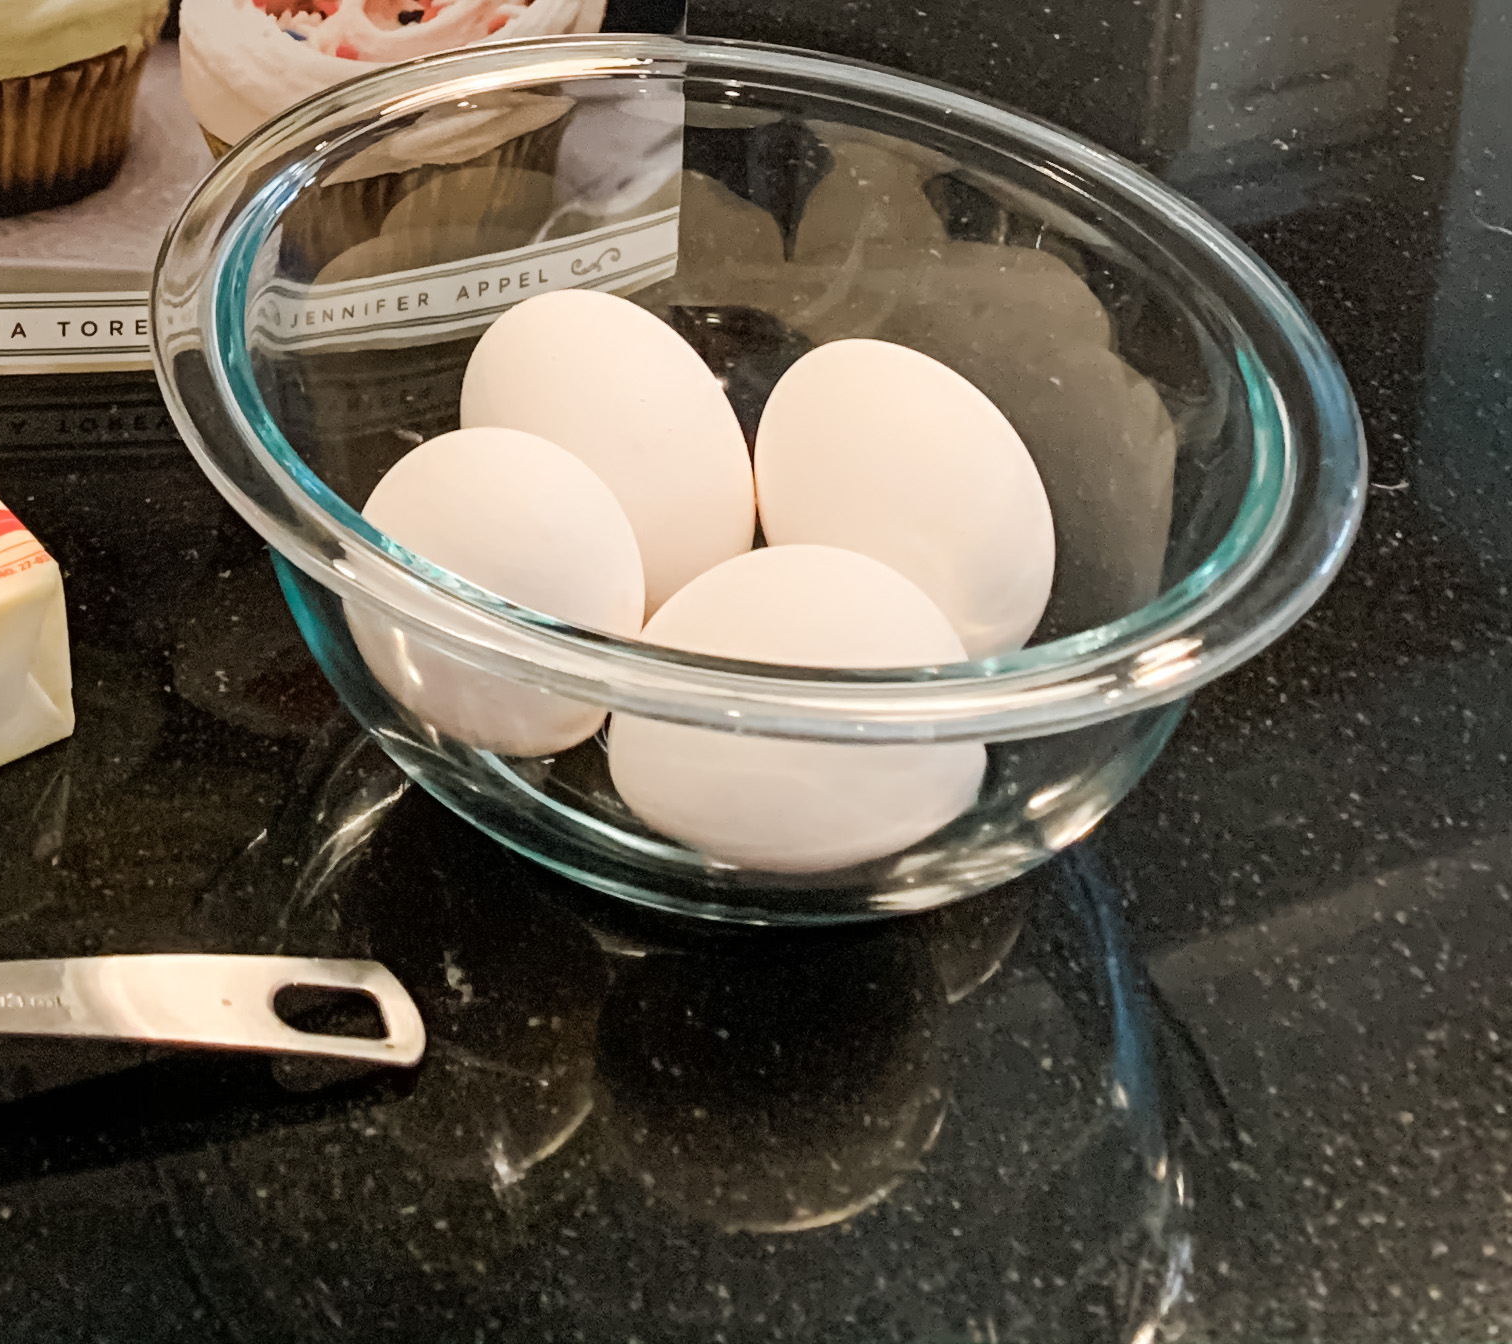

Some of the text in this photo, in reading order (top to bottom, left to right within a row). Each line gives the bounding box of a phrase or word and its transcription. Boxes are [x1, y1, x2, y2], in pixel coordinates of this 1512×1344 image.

[290, 268, 550, 329] JENNIFER APPEL
[57, 319, 148, 337] TORE
